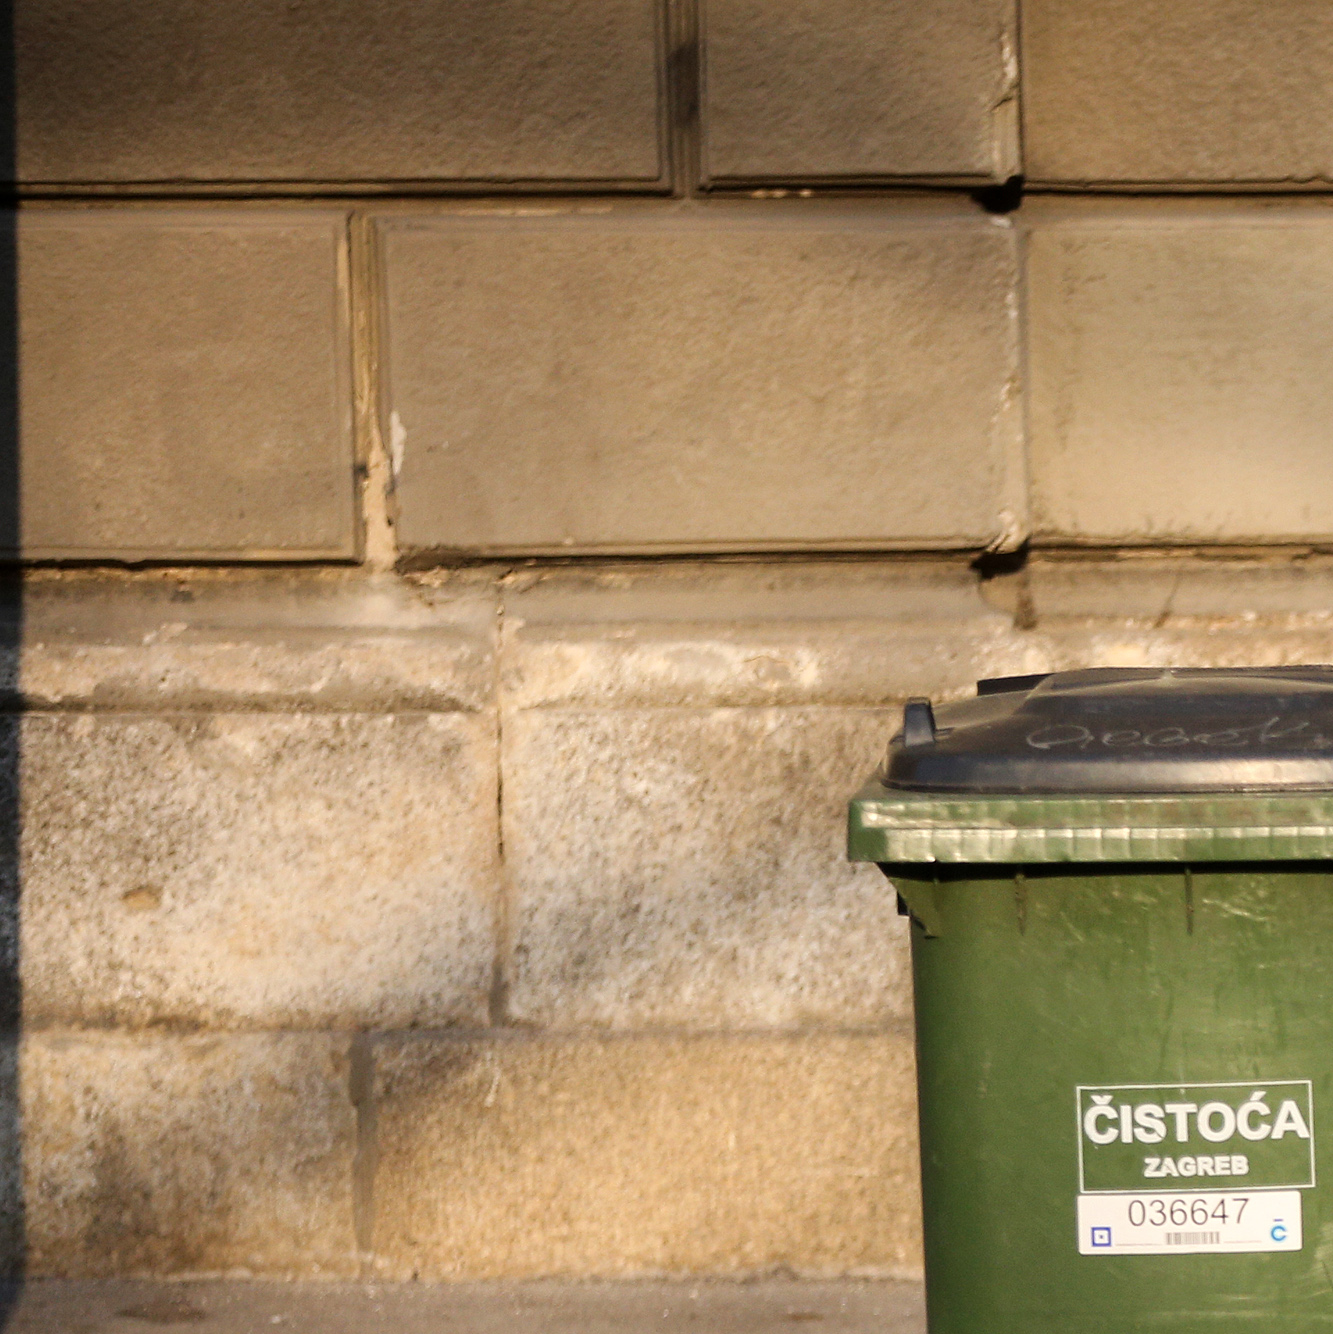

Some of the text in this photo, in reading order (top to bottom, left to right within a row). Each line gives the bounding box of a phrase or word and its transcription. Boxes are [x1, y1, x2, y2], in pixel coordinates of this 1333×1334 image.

[1083, 1091, 1310, 1144] ČISTOĆA
[1143, 1154, 1249, 1178] ZAGREB
[1128, 1198, 1249, 1227] 036647
